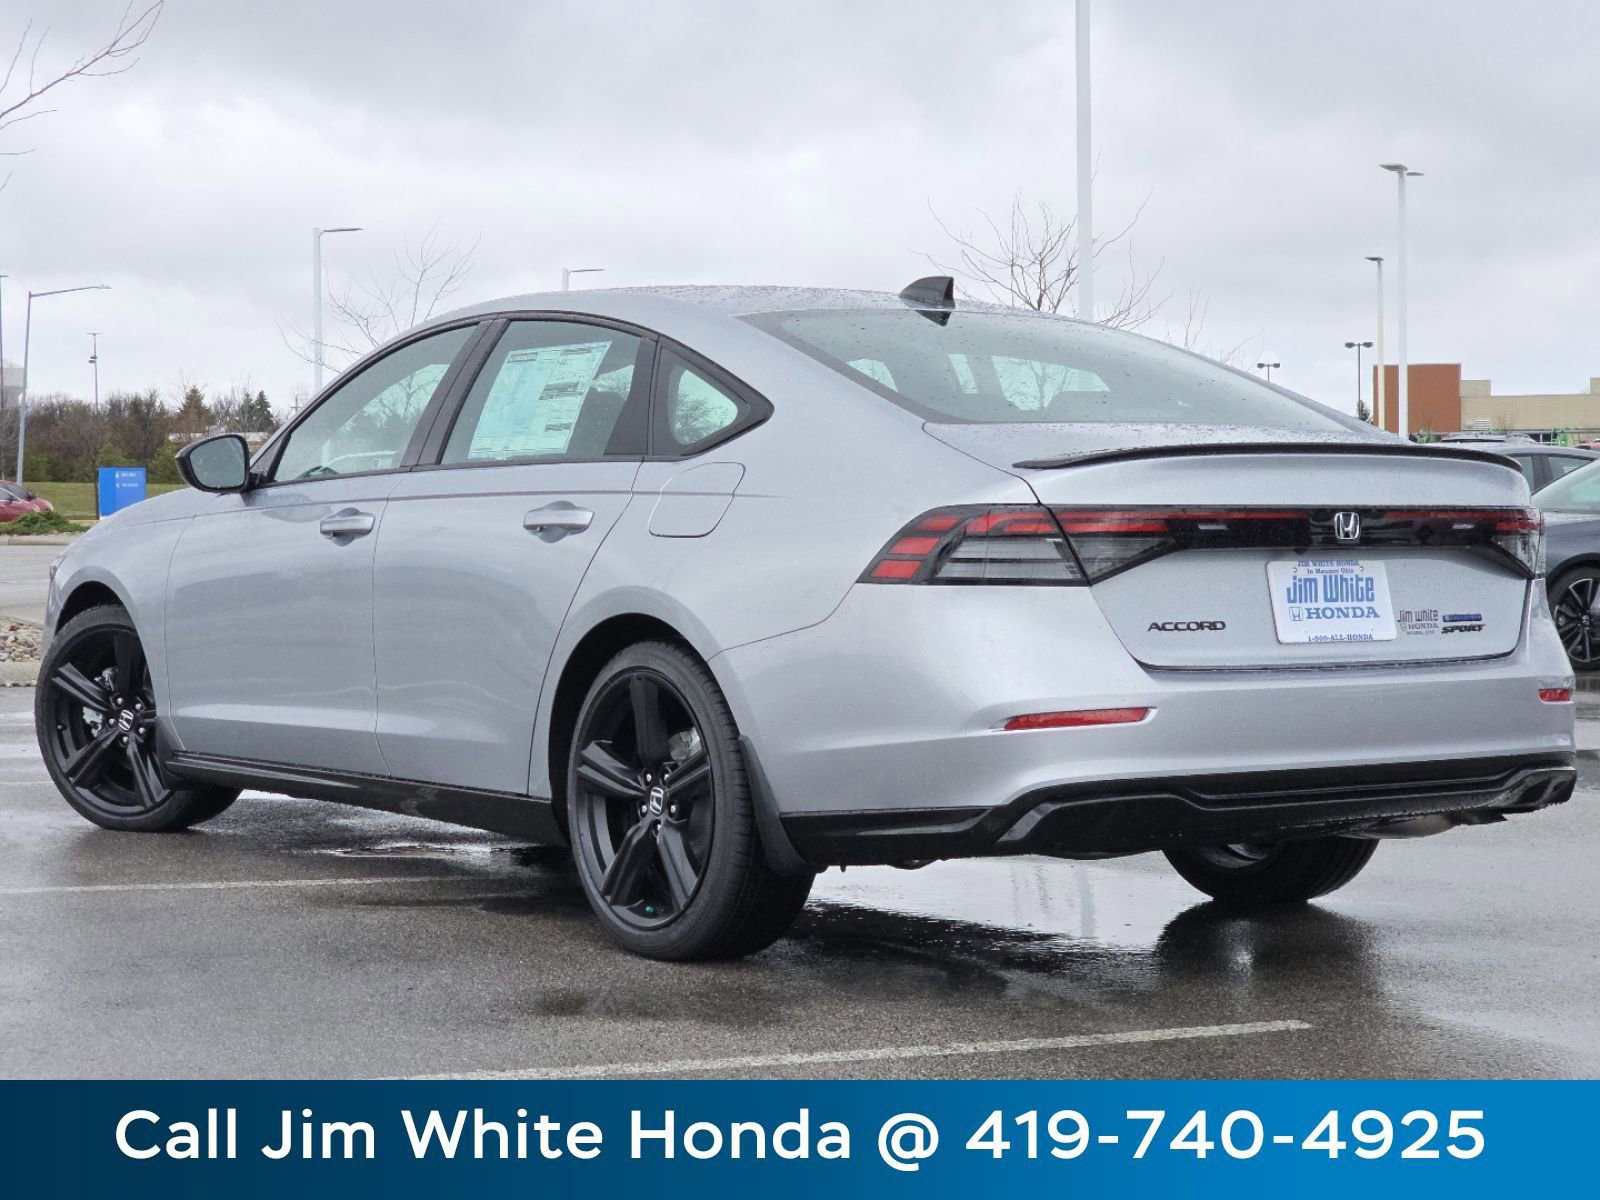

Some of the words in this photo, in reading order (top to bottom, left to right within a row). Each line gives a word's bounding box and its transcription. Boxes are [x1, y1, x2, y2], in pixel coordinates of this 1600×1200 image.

[1323, 574, 1375, 603] White
[1305, 606, 1380, 619] HONDA
[1147, 620, 1226, 632] ACCORD
[1408, 622, 1439, 630] HONDA
[1441, 623, 1486, 634] SPORT
